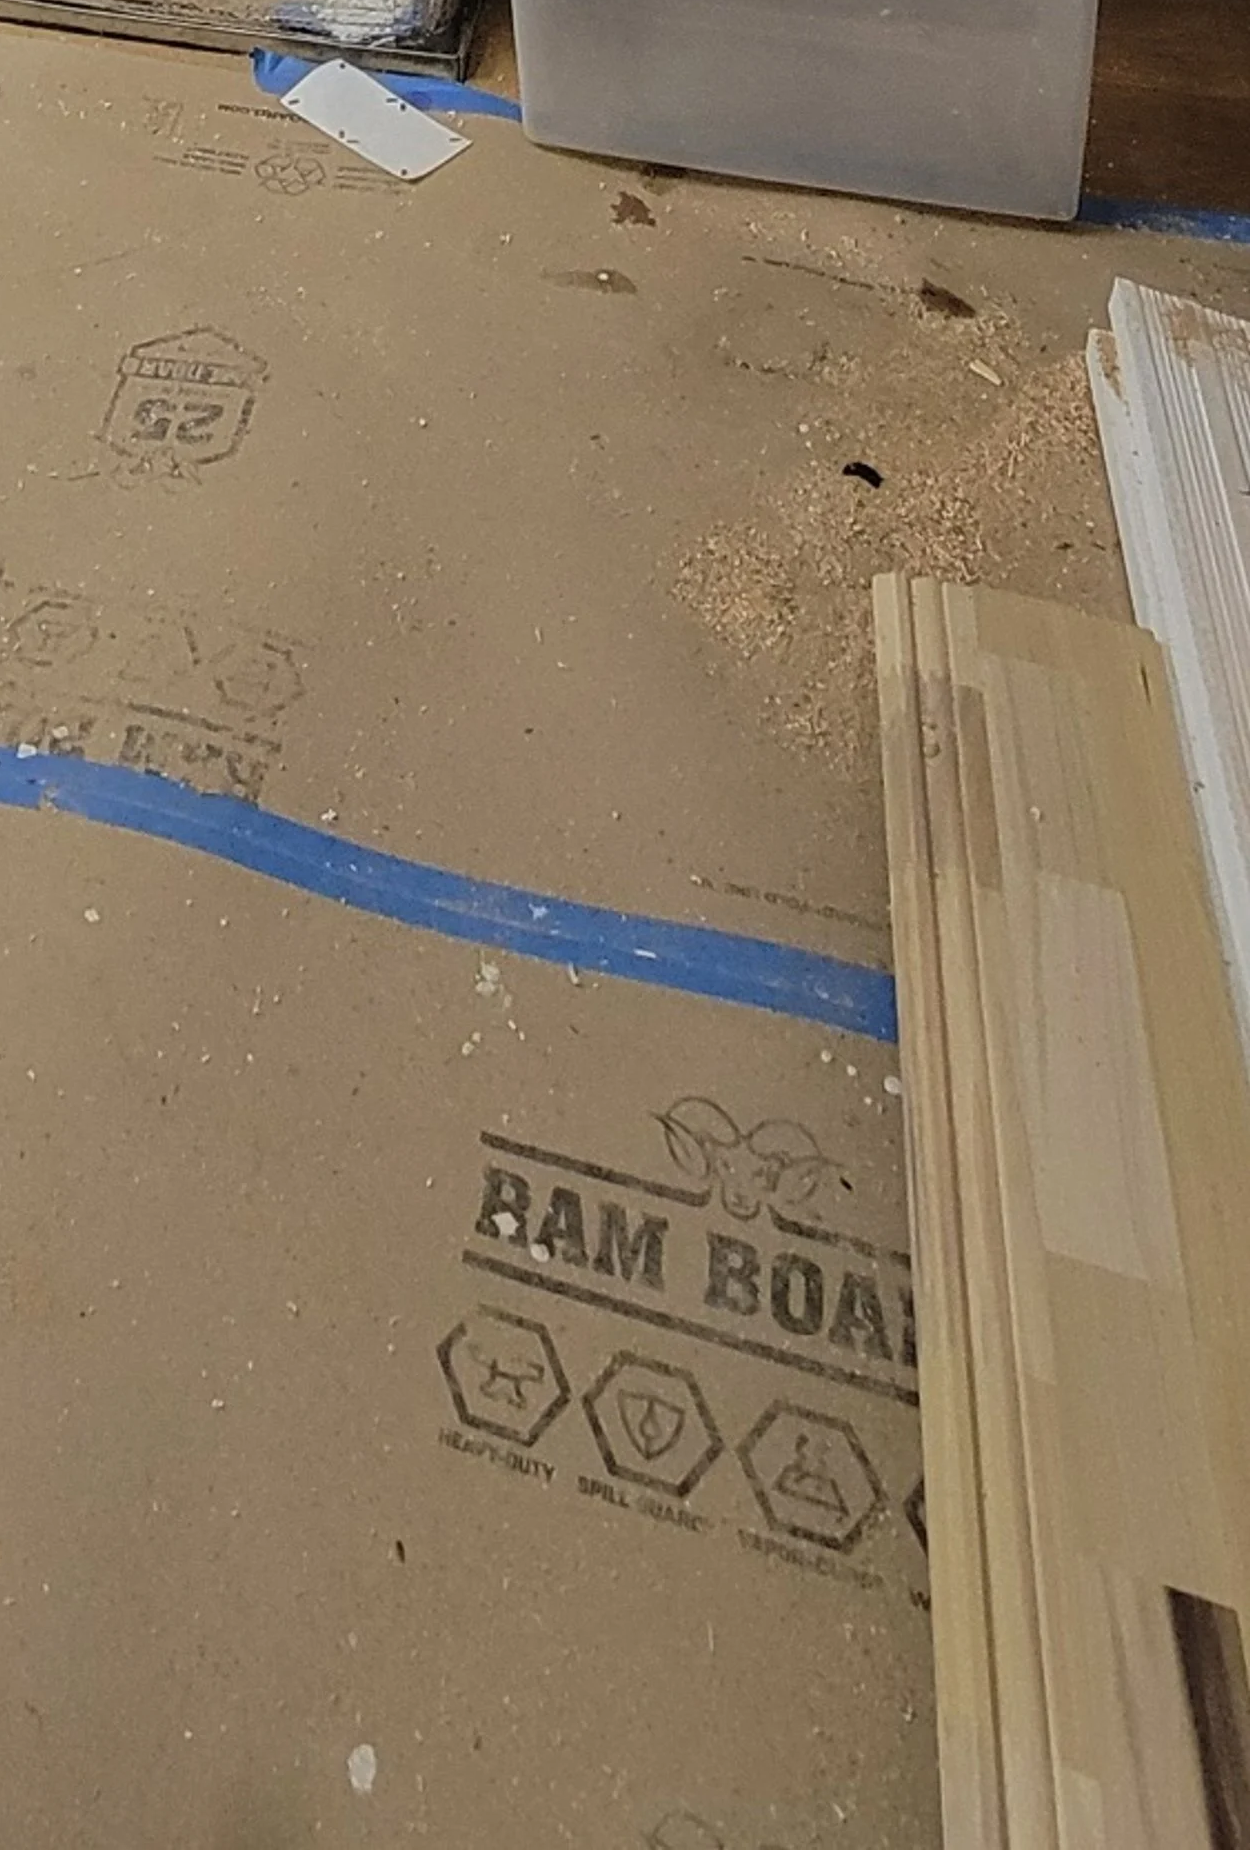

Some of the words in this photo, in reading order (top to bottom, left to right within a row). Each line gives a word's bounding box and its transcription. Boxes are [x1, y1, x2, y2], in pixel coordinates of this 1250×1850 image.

[134, 398, 225, 445] 25
[474, 1165, 669, 1293] RAM
[437, 1427, 556, 1484] HEAVY-DUTY
[576, 1474, 631, 1509] SPILL
